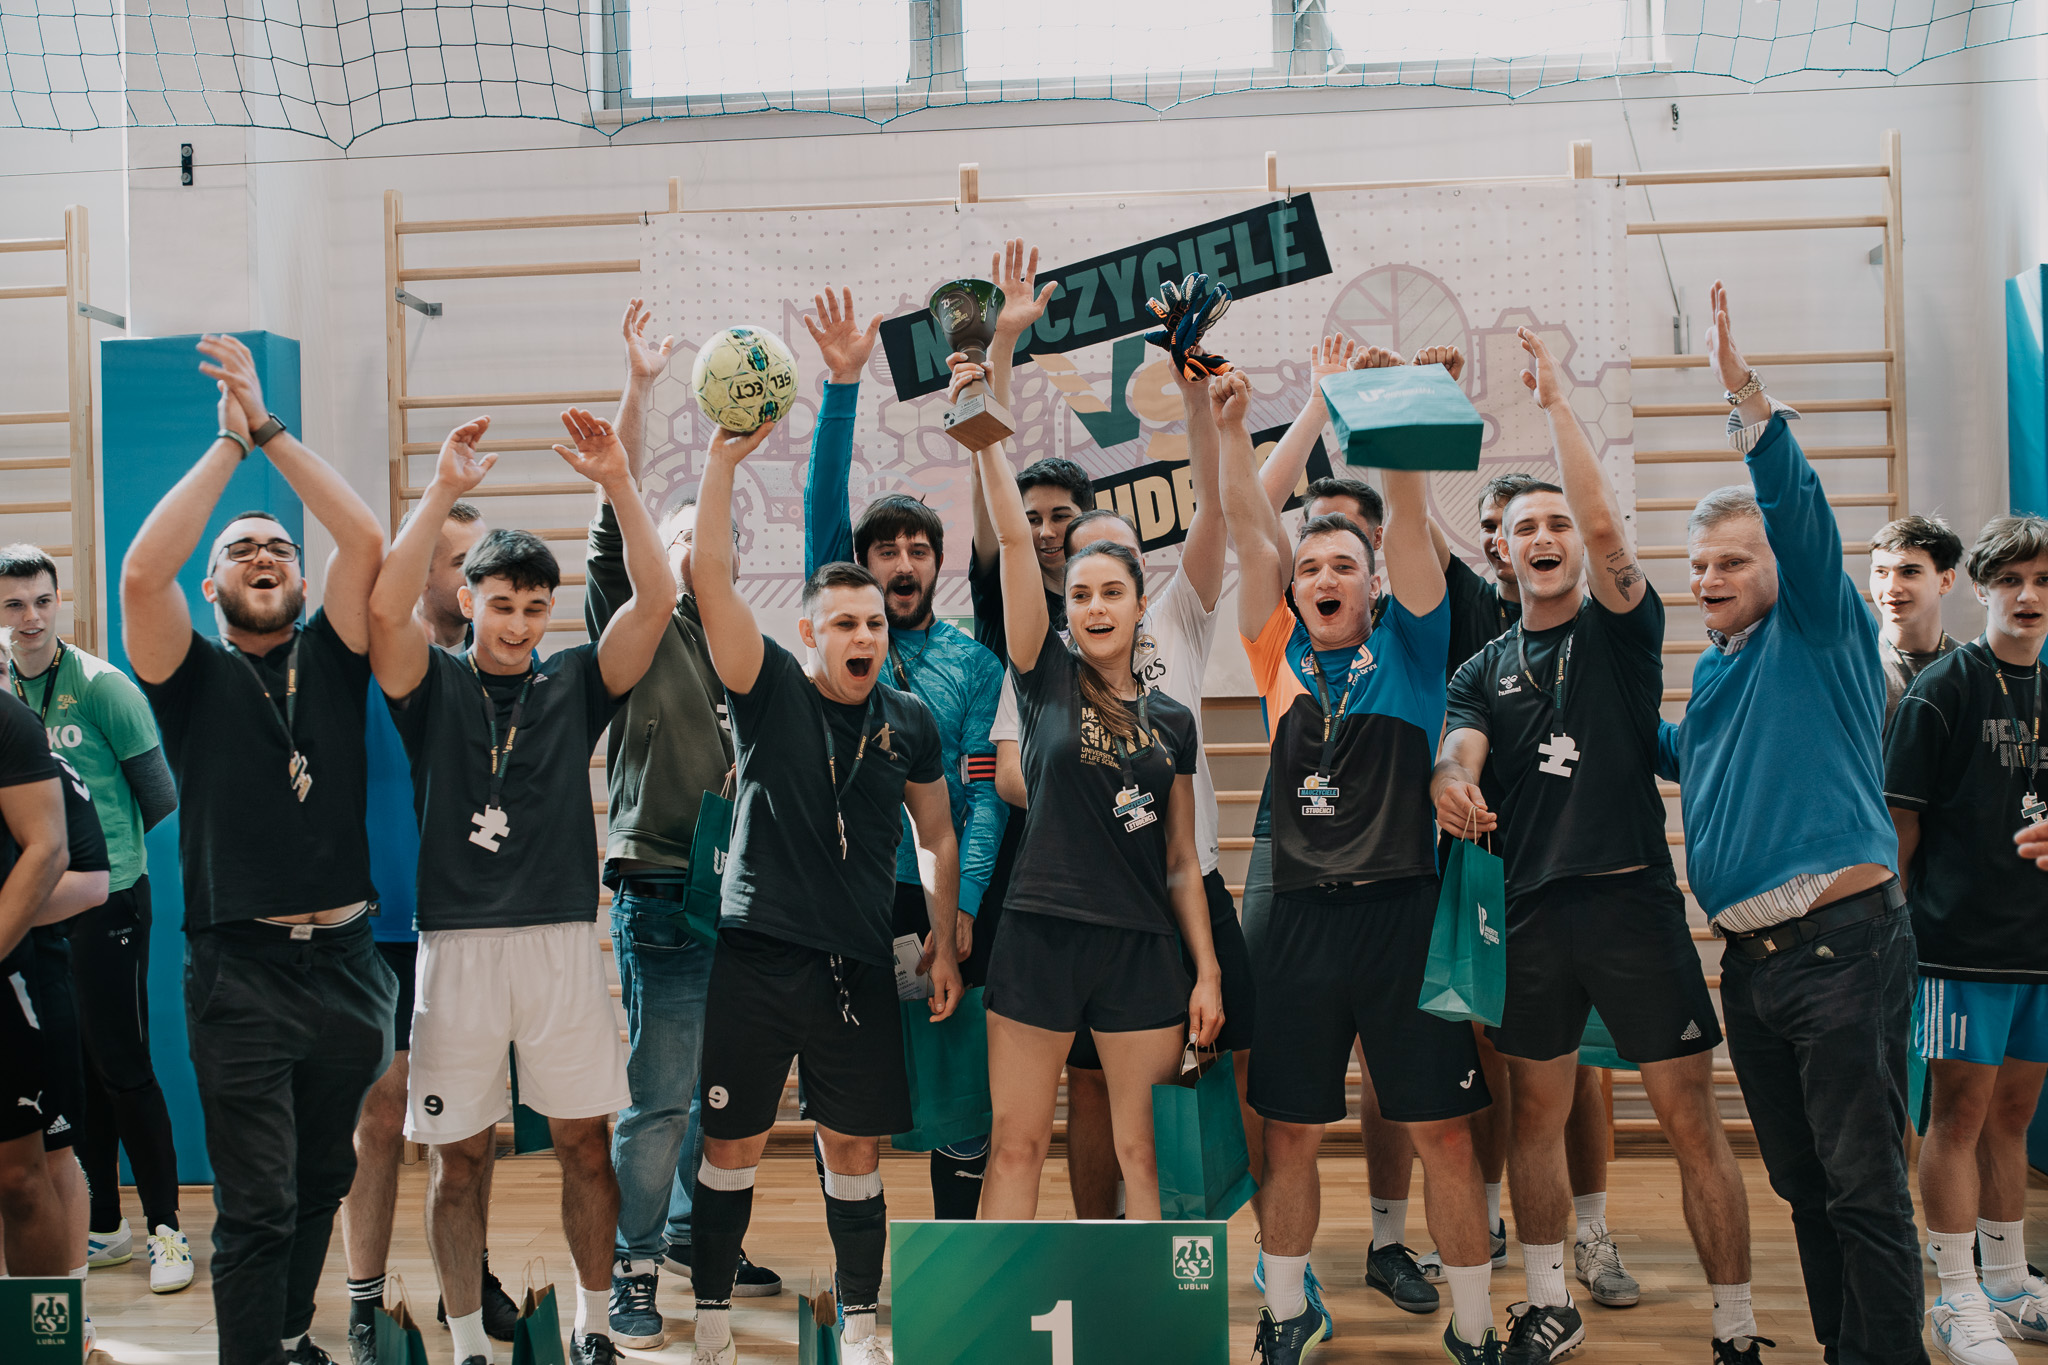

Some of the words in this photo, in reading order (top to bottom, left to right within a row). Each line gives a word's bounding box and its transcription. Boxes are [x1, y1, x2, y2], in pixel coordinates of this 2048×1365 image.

[911, 206, 1307, 384] NCZYCIELE
[46, 724, 83, 750] KO
[1081, 746, 1115, 761] UNIVERSITY
[1031, 1300, 1074, 1365] 1
